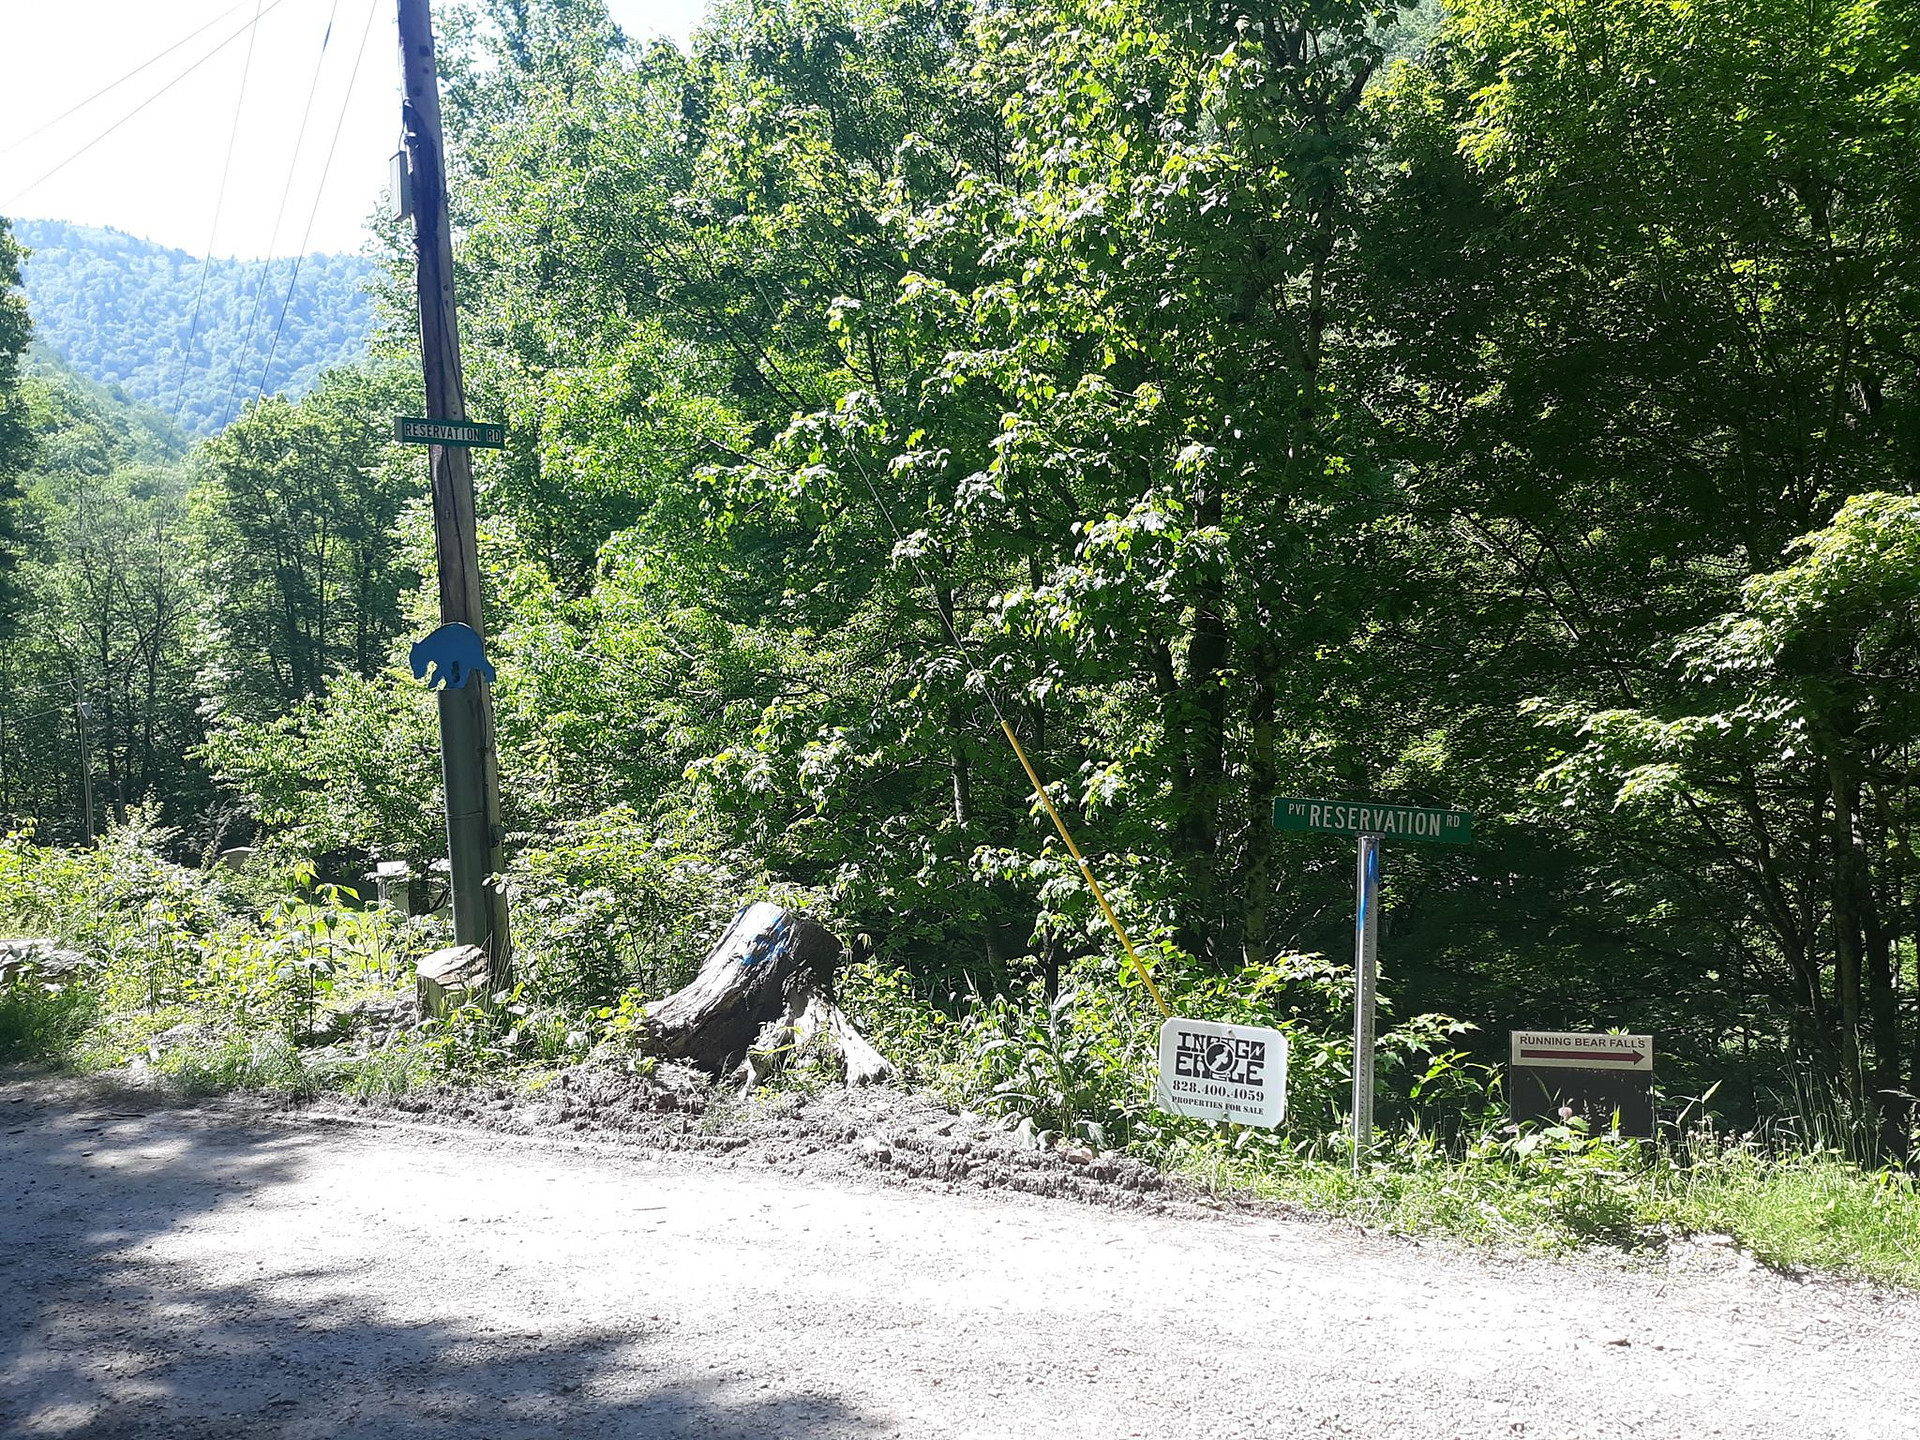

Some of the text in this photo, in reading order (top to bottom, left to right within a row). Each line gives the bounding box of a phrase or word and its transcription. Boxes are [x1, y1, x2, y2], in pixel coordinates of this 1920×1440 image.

[405, 424, 500, 442] RESERVATION RD
[1288, 803, 1460, 836] PVT RESERVATION RD
[1520, 1036, 1646, 1049] RUNNING BEAR FALLS
[1173, 1080, 1264, 1102] 828.400.4059
[1172, 1096, 1264, 1115] PROPERTIES FOR SALE
